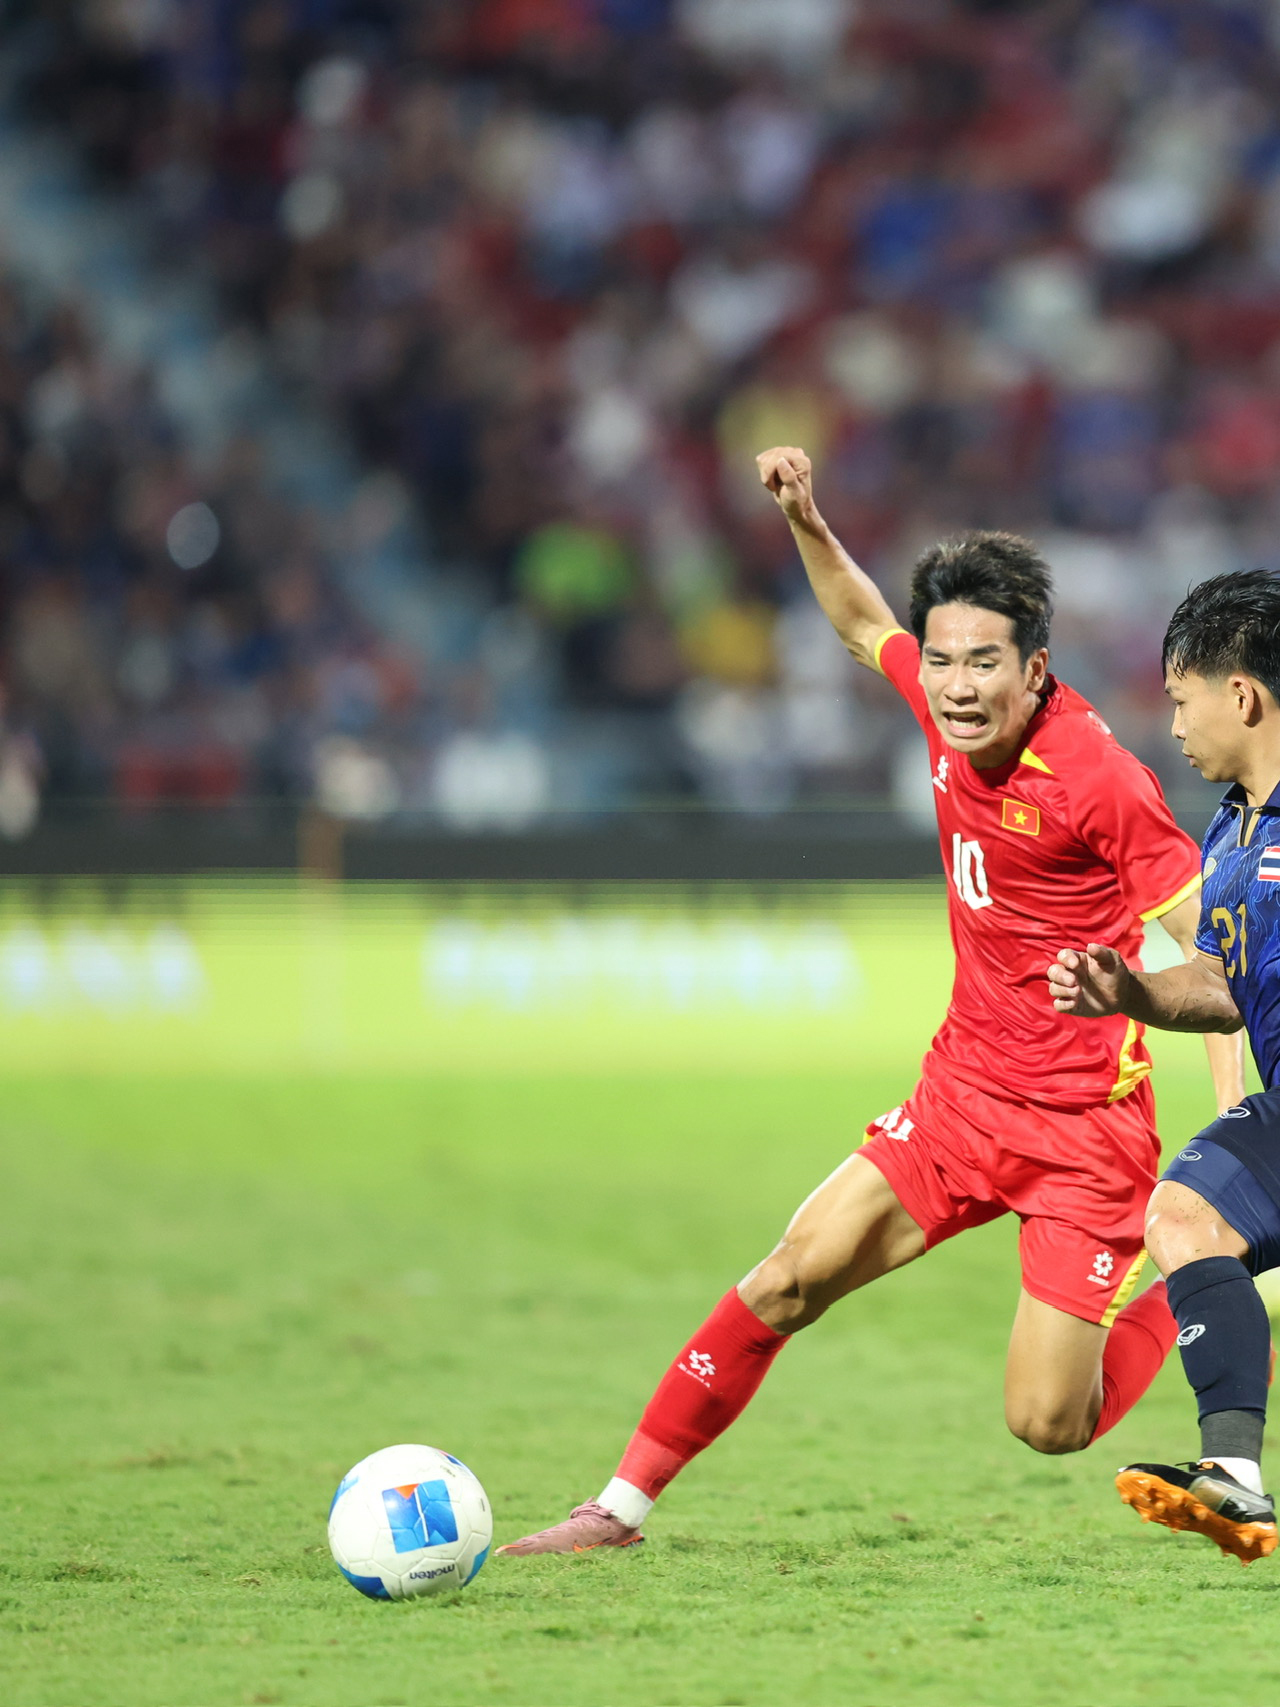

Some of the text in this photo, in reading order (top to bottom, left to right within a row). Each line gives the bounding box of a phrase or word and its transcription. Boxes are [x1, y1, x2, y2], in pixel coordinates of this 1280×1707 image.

[952, 832, 993, 910] 10
[1211, 903, 1247, 979] 21
[410, 1563, 455, 1580] molten
